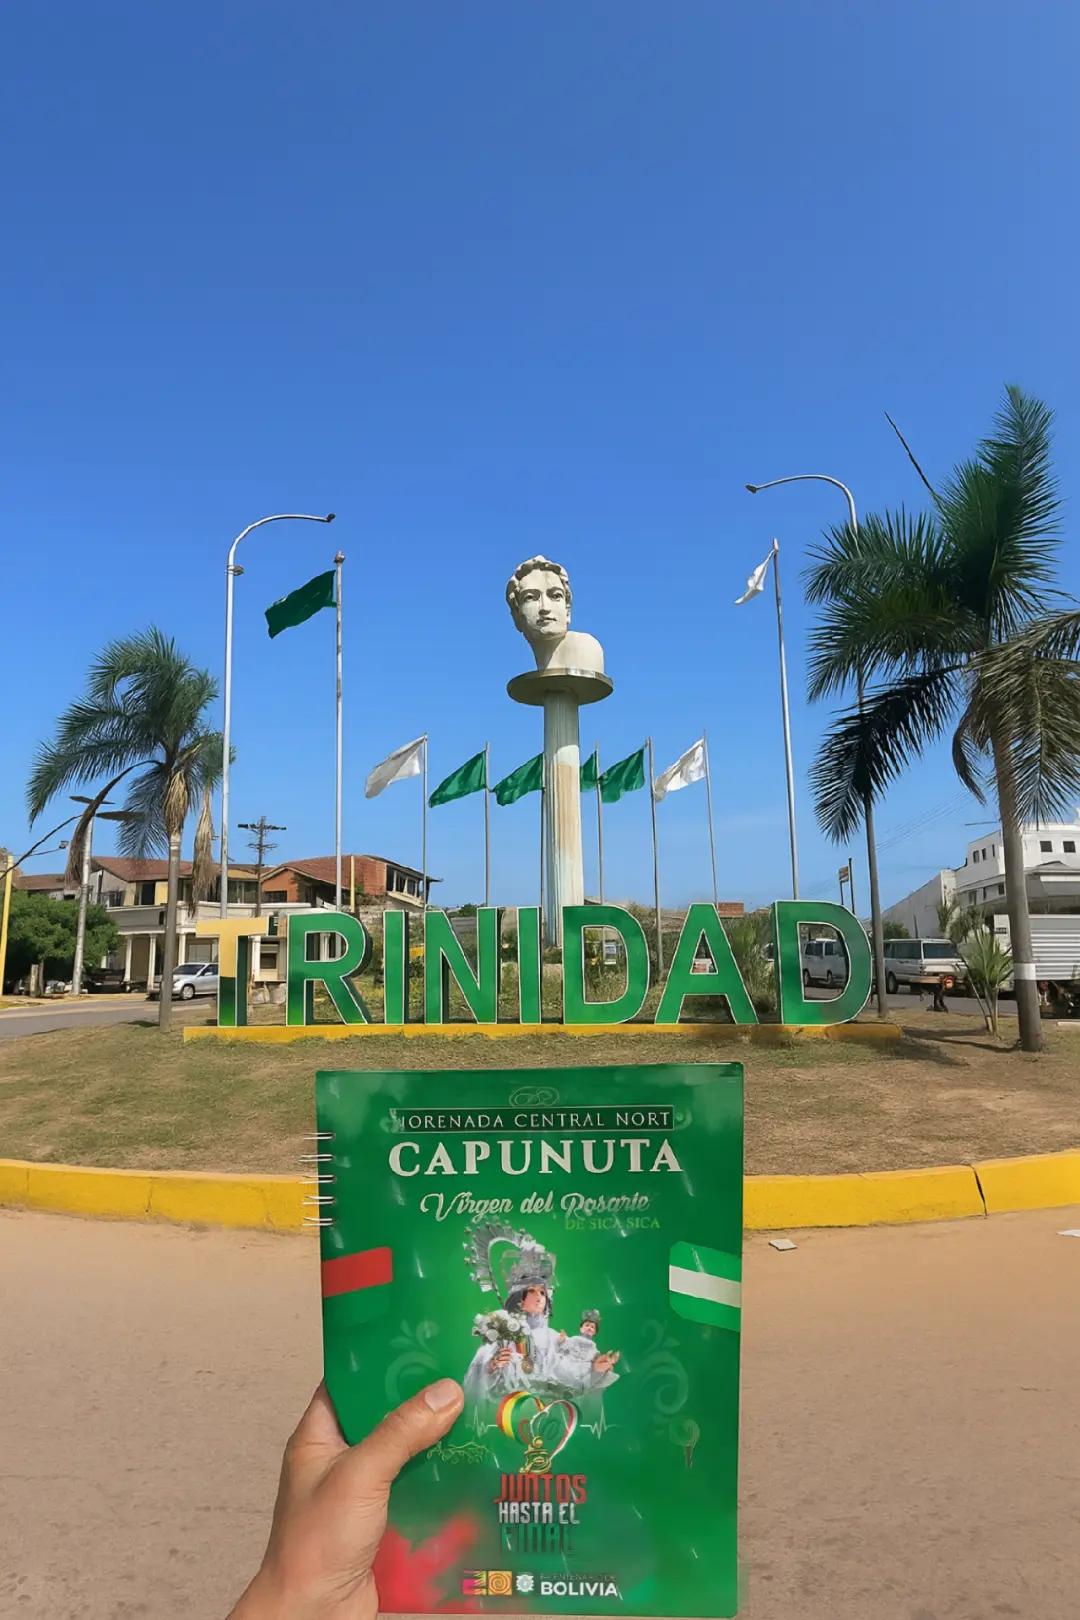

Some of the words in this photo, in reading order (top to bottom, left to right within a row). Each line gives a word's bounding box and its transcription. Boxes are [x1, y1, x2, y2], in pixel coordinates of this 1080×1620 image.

[195, 899, 872, 1027] TRINIDAD
[514, 1112, 605, 1128] CENTRAL
[388, 1138, 684, 1177] CAPUNUTA
[420, 1191, 514, 1224] Virgen
[520, 1190, 554, 1214] del
[565, 1217, 586, 1231] DE
[626, 1216, 661, 1229] SICA
[493, 1473, 588, 1504] JUNTOS
[498, 1502, 553, 1524] HASTA
[559, 1502, 580, 1524] EL
[540, 1582, 618, 1597] BOLIVIA
